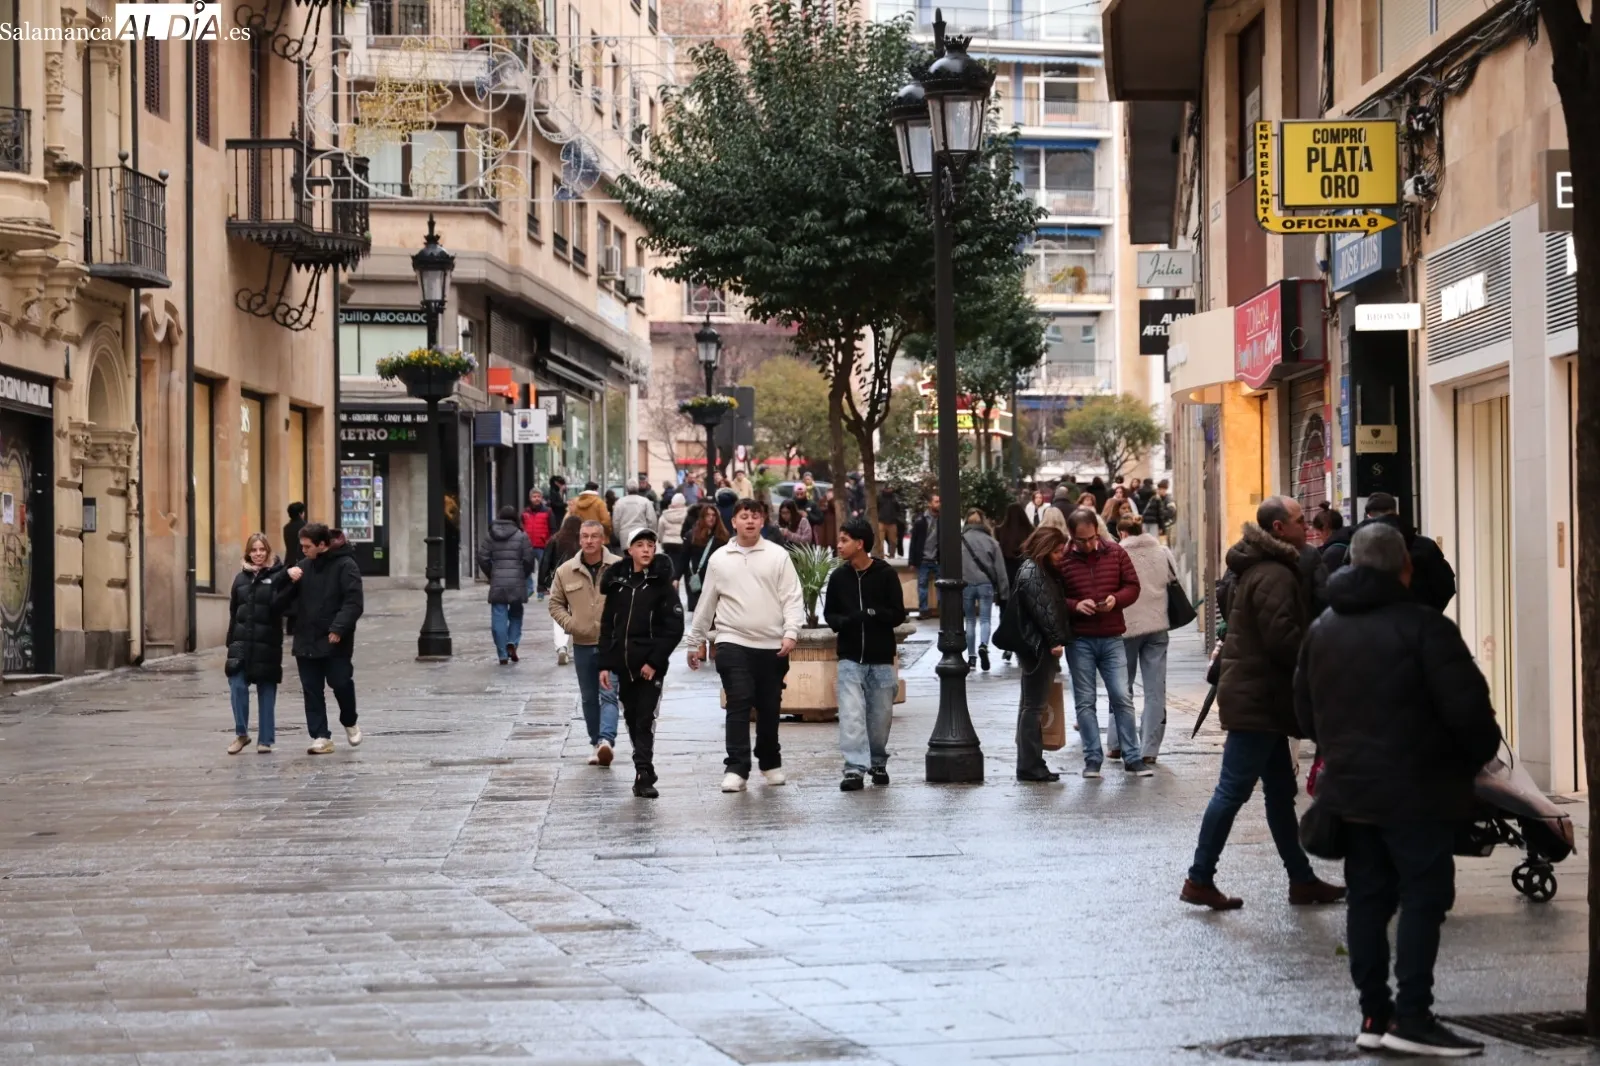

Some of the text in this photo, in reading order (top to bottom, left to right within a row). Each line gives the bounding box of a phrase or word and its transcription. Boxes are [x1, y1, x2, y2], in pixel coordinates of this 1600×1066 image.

[1312, 128, 1366, 144] COMPRO
[1307, 146, 1373, 173] PLATA
[1259, 124, 1270, 223] ENTREPLANTA
[1320, 174, 1359, 199] ORO
[1281, 217, 1378, 229] OFICINA 8
[1340, 233, 1379, 280] JOSE LUIS
[1161, 313, 1193, 324] ALA
[1142, 325, 1170, 336] AFFL
